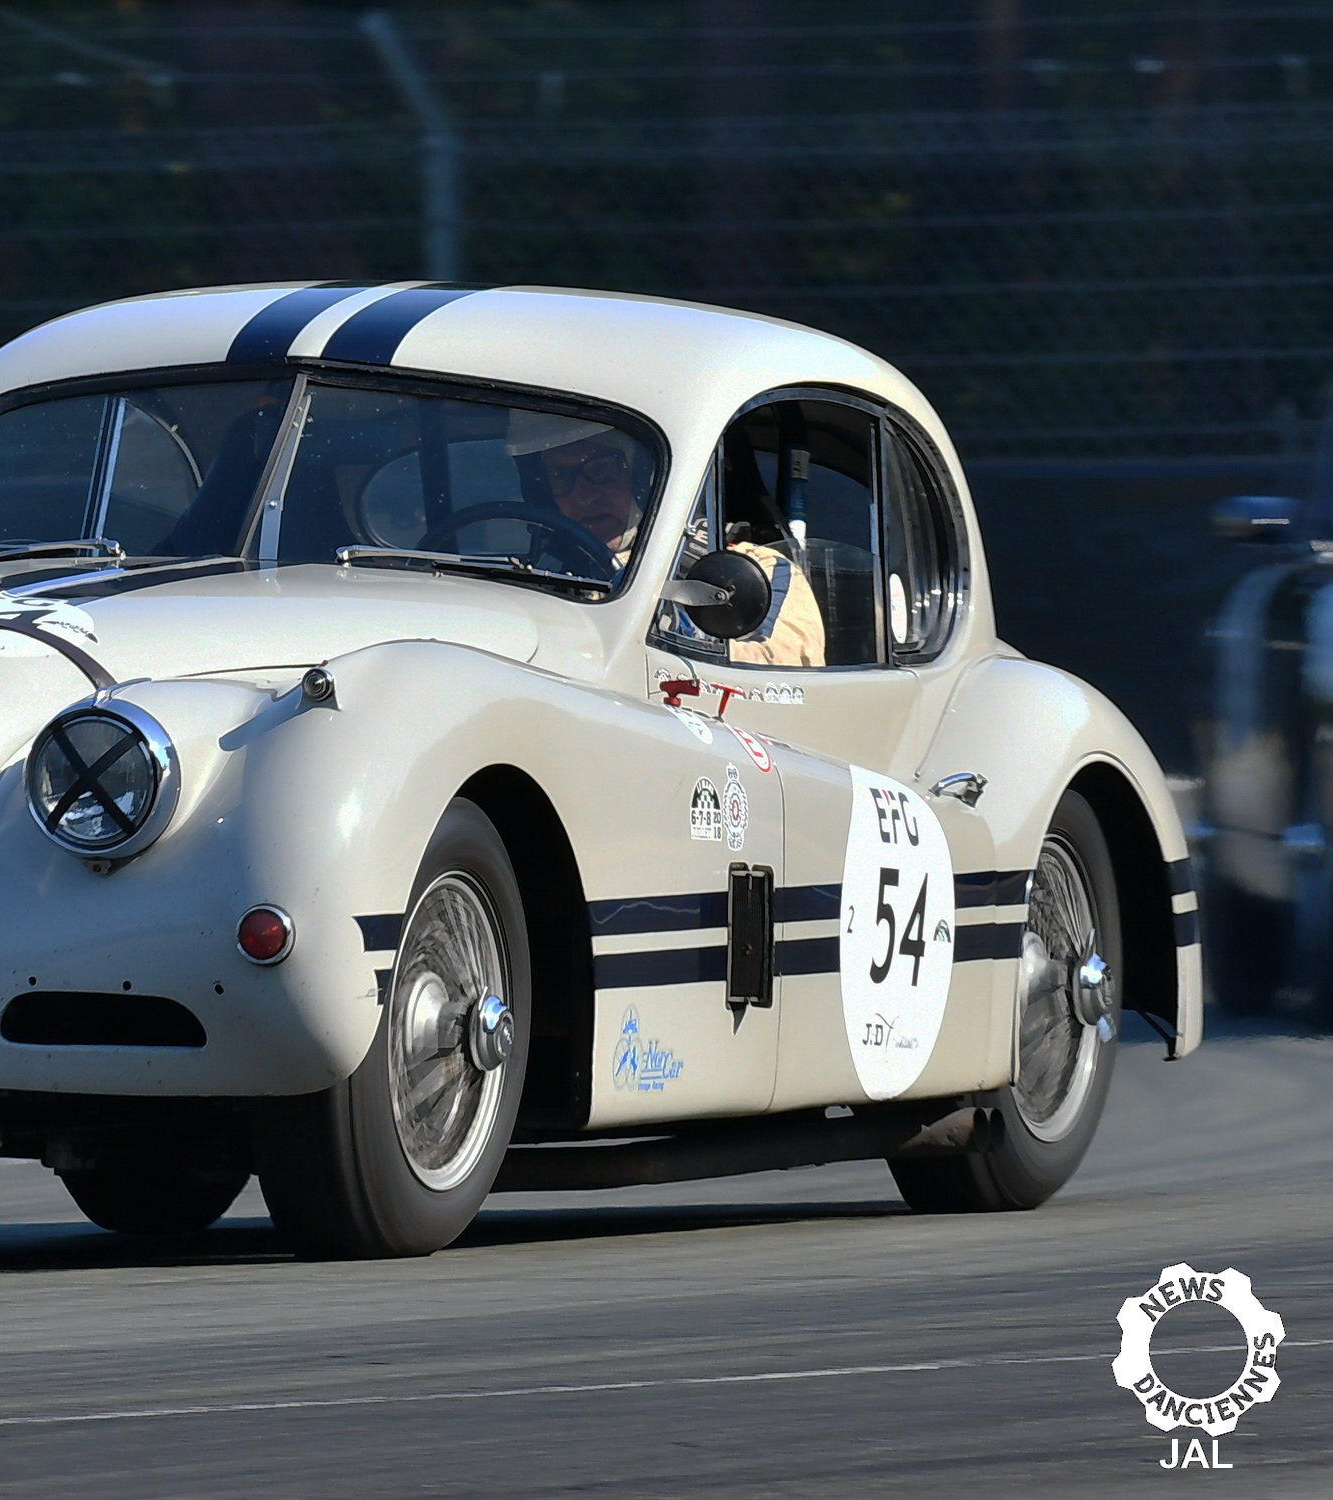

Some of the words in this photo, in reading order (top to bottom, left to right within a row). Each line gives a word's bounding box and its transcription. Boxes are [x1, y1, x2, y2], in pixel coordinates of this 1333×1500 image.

[869, 787, 919, 846] EFG
[846, 905, 855, 934] 2
[870, 866, 928, 987] 54
